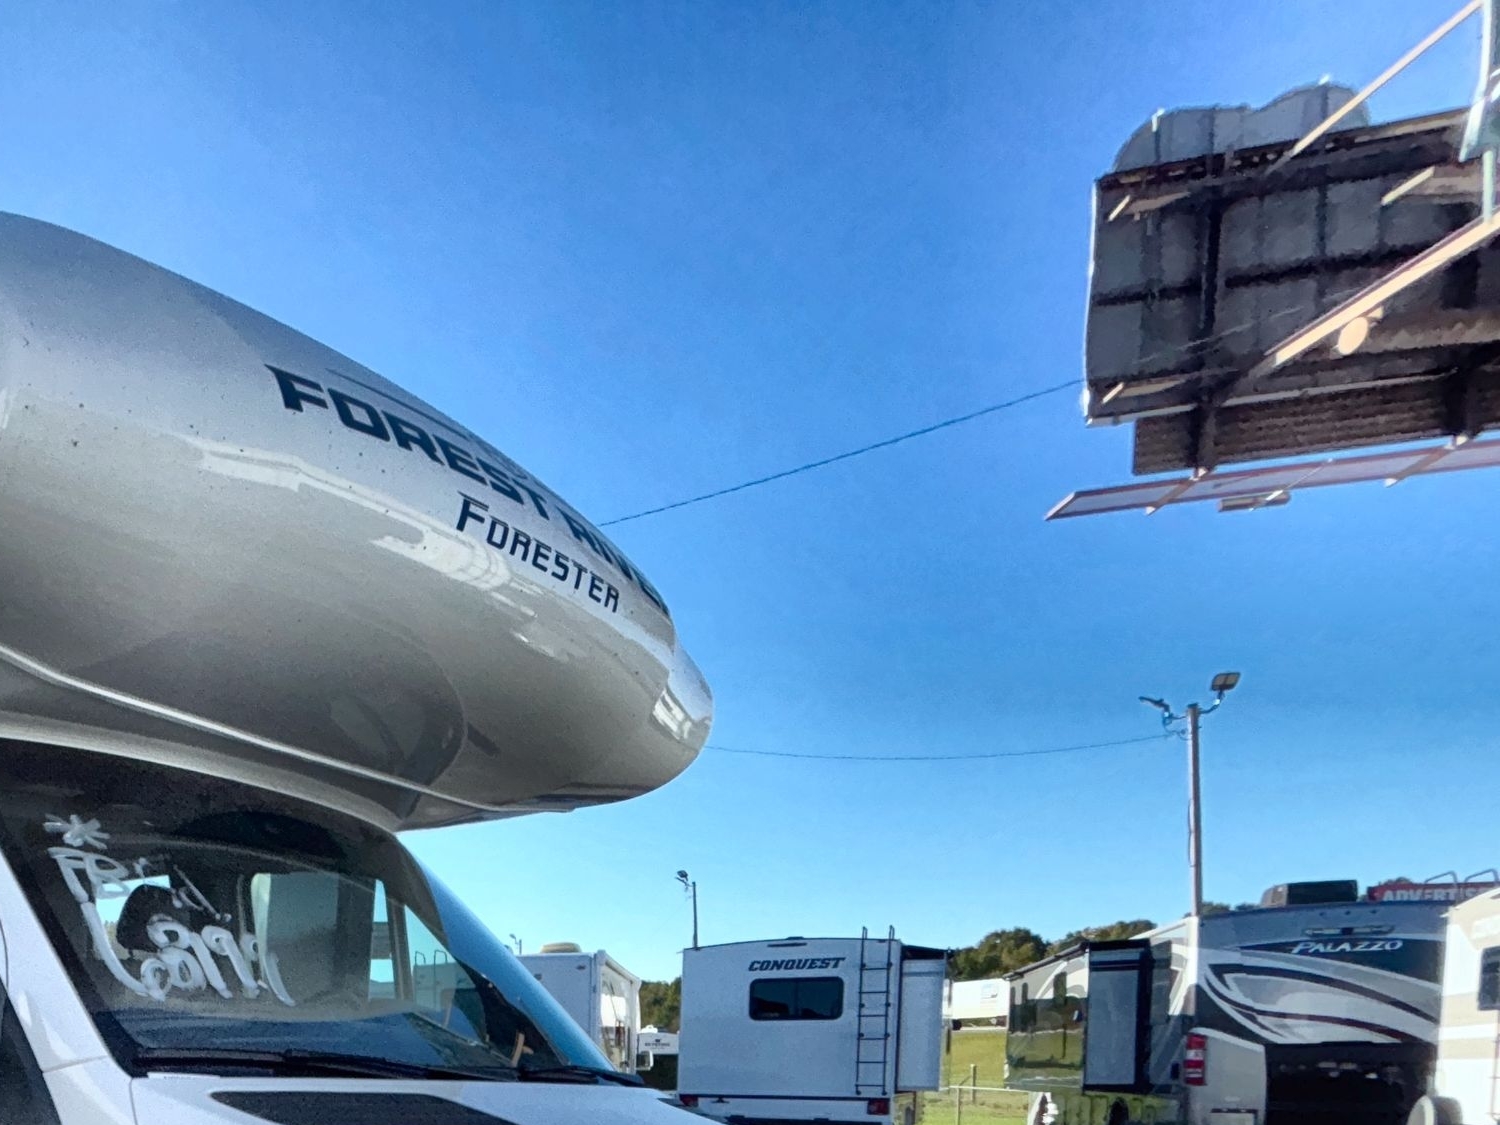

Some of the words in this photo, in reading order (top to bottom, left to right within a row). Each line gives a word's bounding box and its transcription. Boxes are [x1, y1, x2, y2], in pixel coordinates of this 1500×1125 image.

[264, 363, 550, 521] FOREST
[457, 490, 620, 613] FORESTER
[748, 956, 847, 972] CONQUEST
[1291, 940, 1404, 954] PALAZZO
